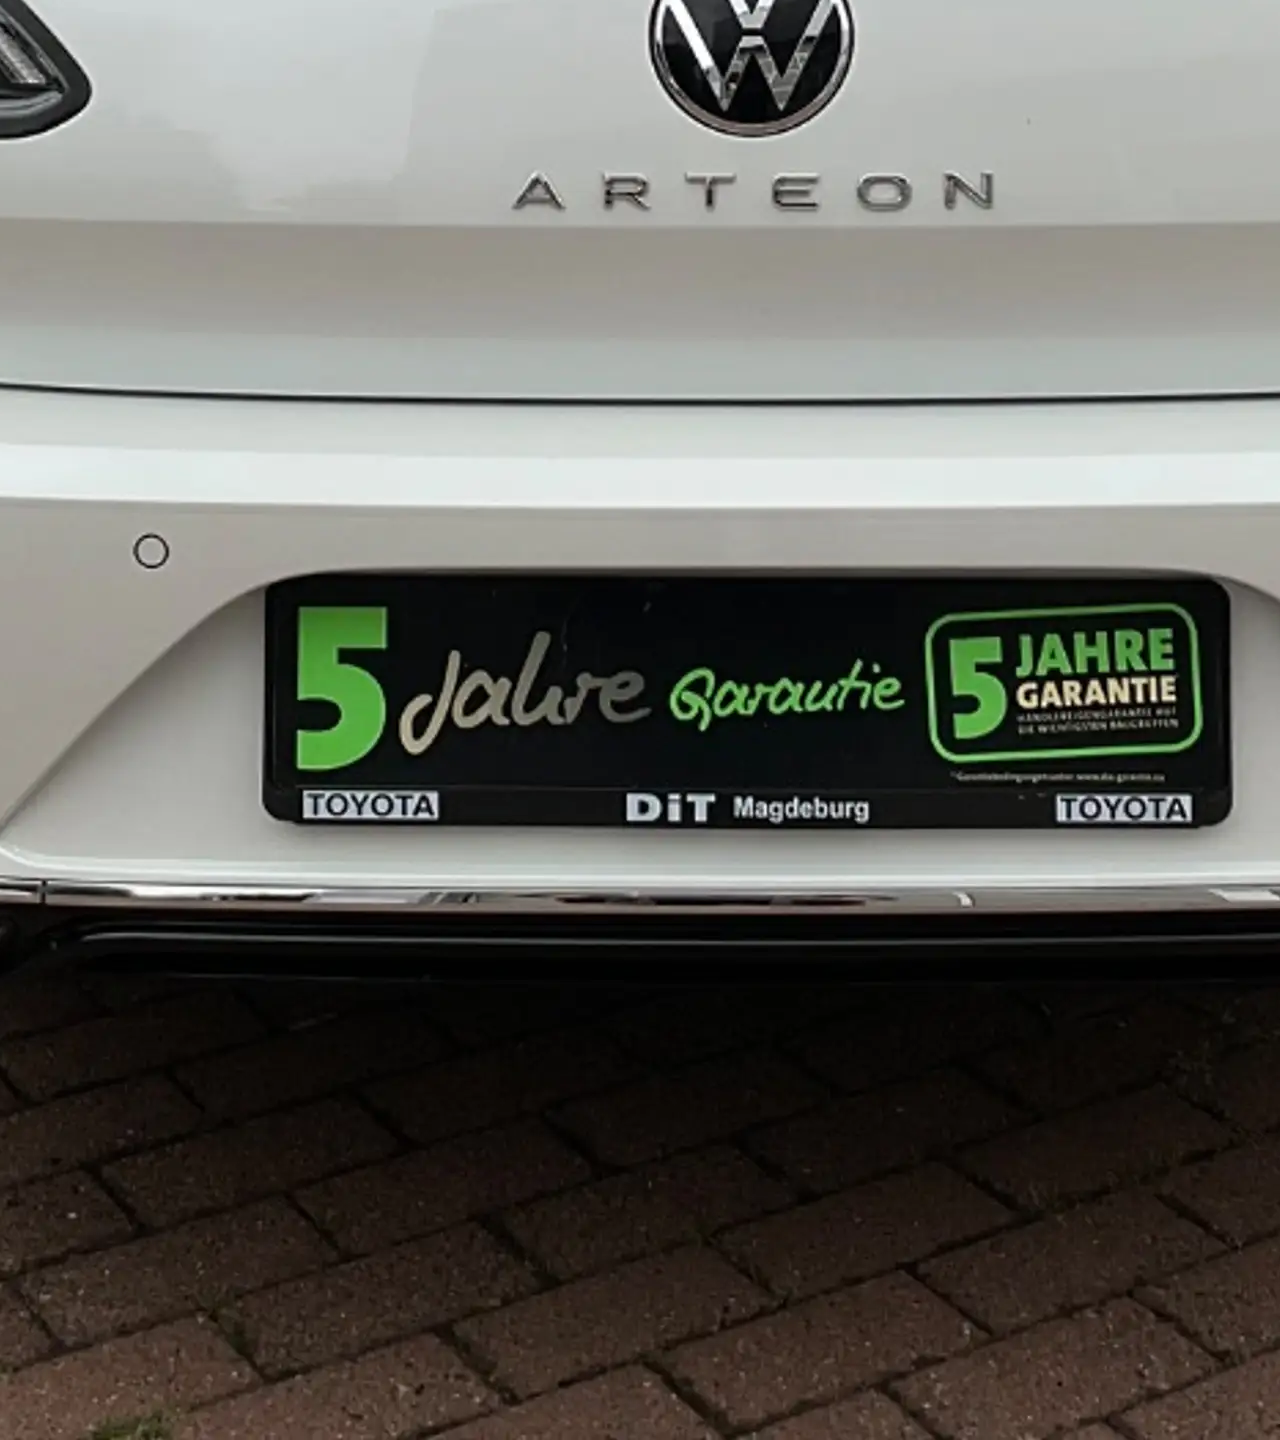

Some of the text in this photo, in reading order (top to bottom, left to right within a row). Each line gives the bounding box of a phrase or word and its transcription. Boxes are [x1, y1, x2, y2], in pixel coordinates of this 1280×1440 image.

[512, 171, 994, 212] ARTEON
[1016, 627, 1175, 678] JAHRE
[297, 606, 905, 771] 5 Jahre Garantie
[950, 636, 1007, 739] 5
[1016, 675, 1178, 709] GARANTIE
[307, 792, 435, 817] TOYOTA
[733, 796, 870, 824] Magdeburg
[1060, 796, 1188, 821] TOYOTA
